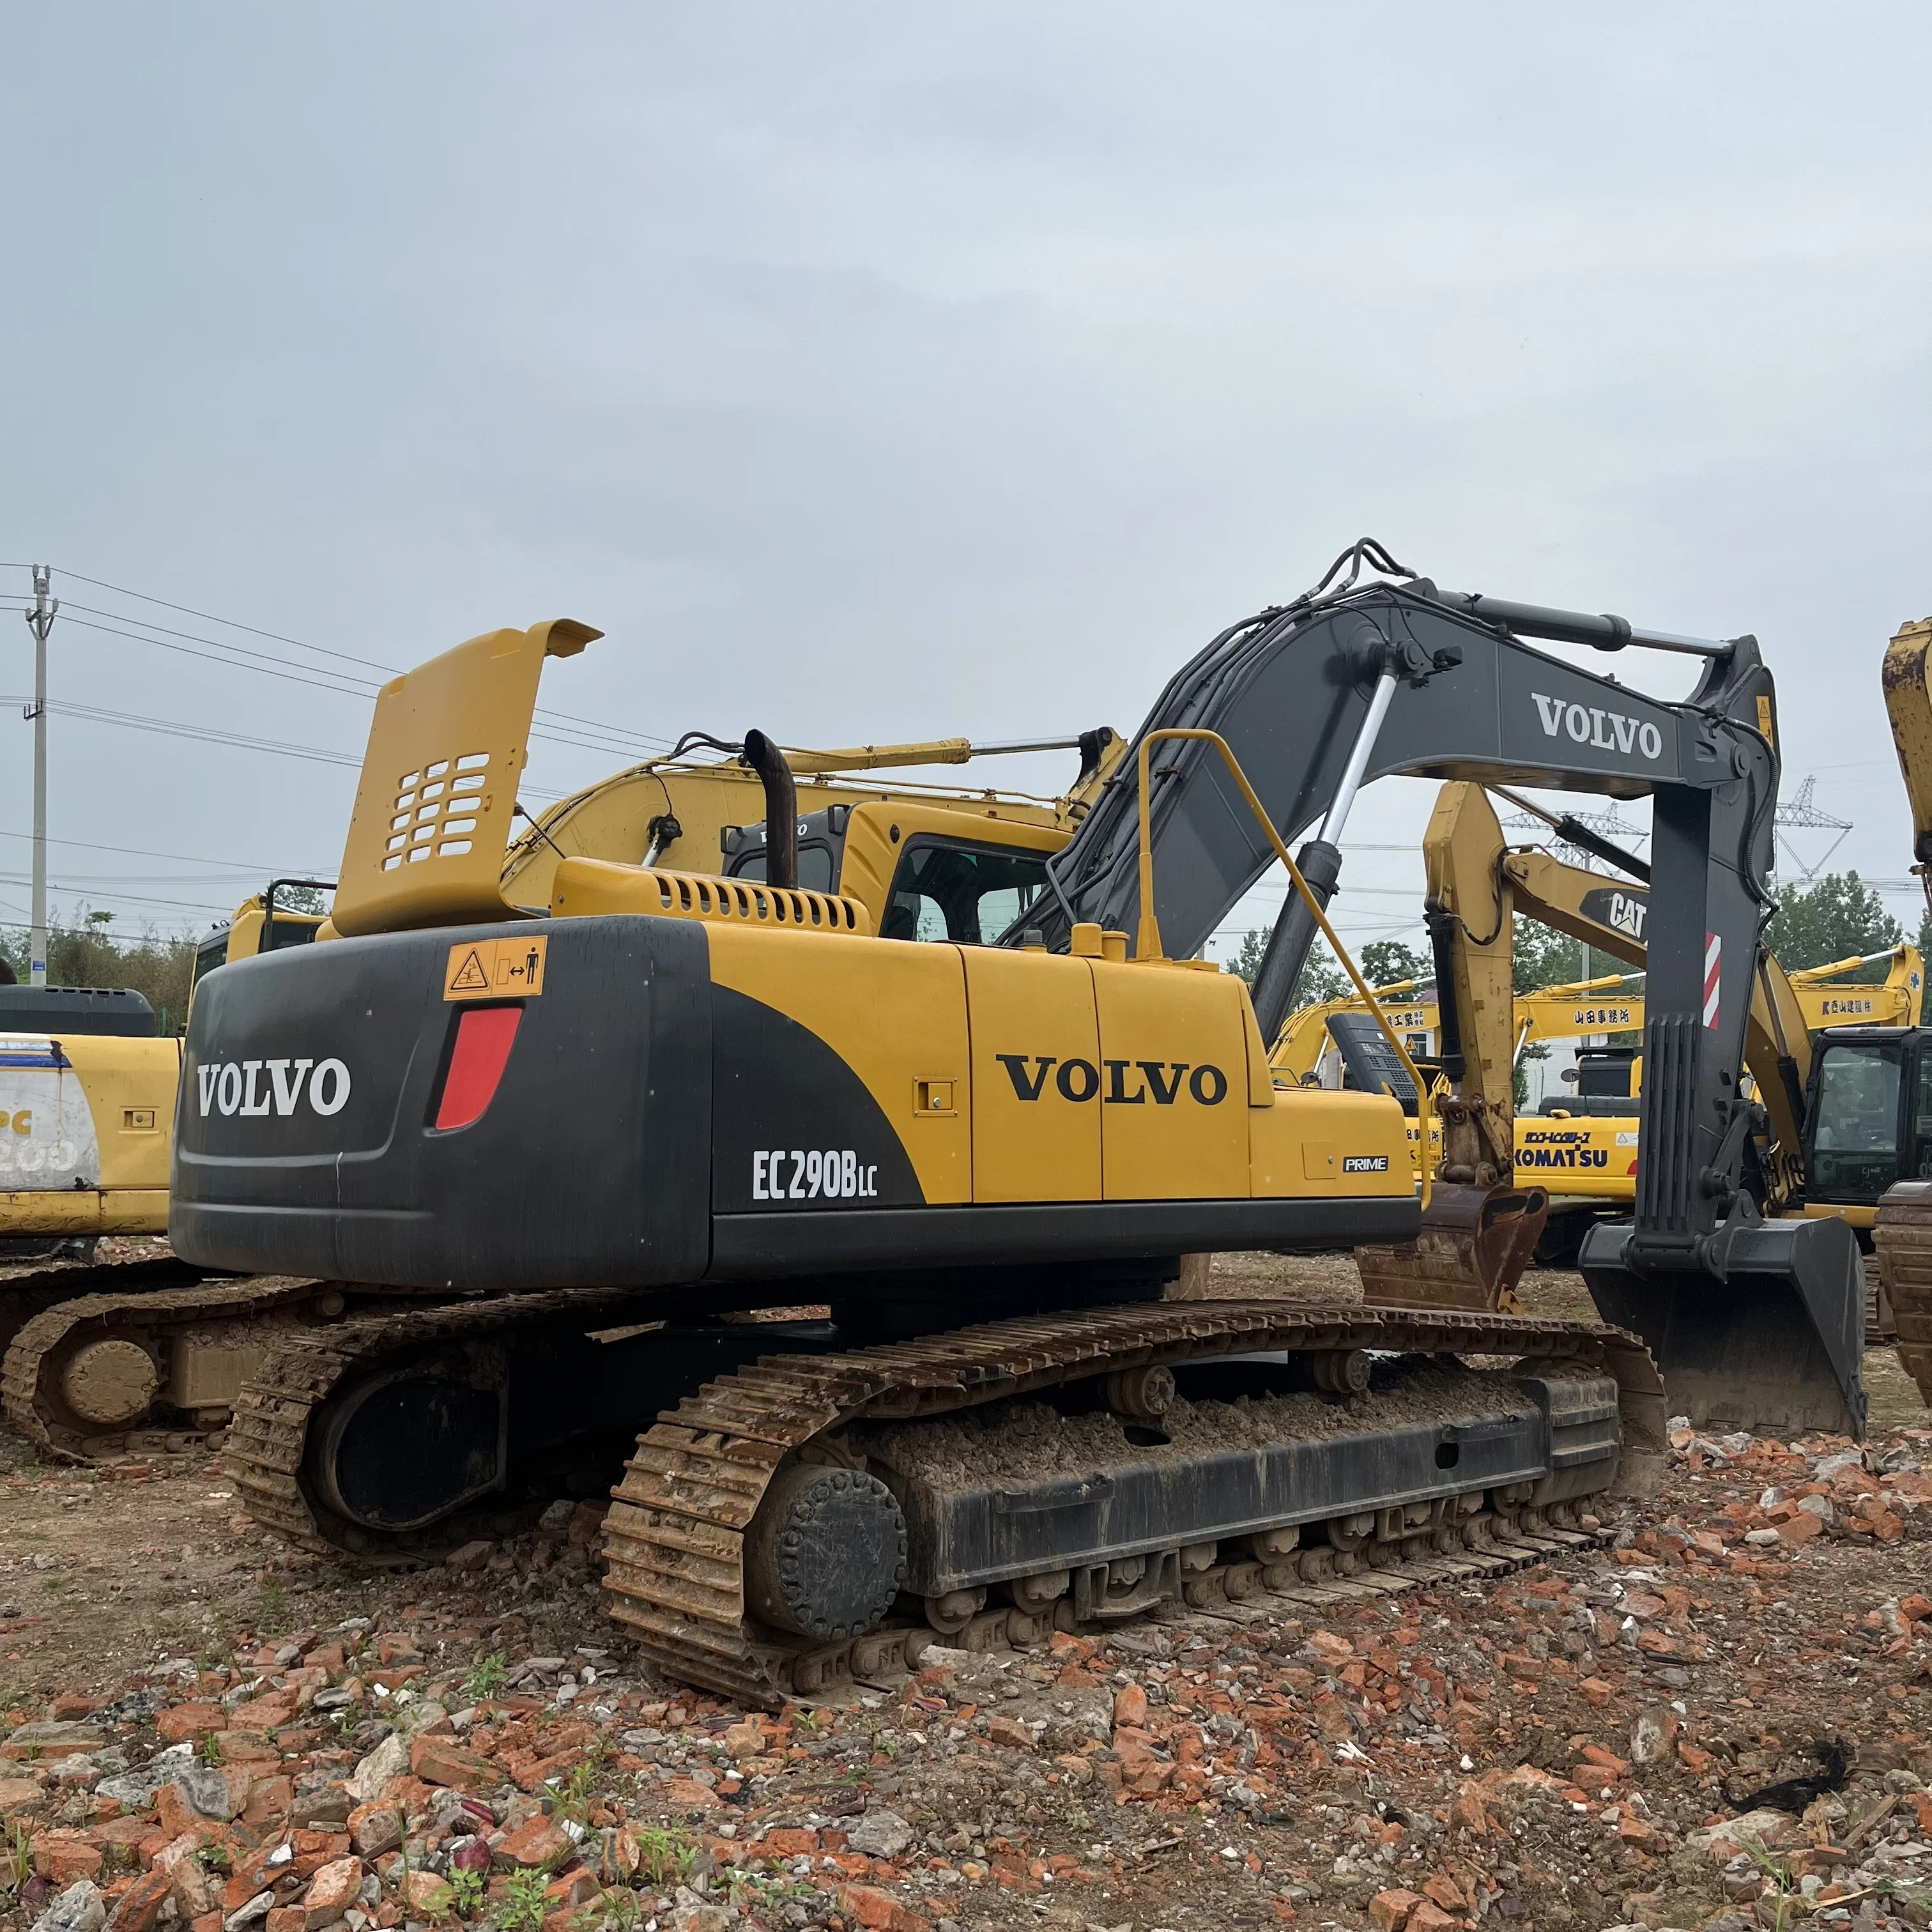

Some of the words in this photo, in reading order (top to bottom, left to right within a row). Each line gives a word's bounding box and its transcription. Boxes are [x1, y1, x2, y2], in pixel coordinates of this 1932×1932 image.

[1531, 693, 1662, 759] VOLVO
[1610, 893, 1647, 938] CAT
[1575, 1009, 1629, 1024] 山田事務所
[197, 1058, 351, 1116] VOLVO
[996, 1054, 1227, 1105] VOLVO
[1346, 1158, 1386, 1170] PRIME
